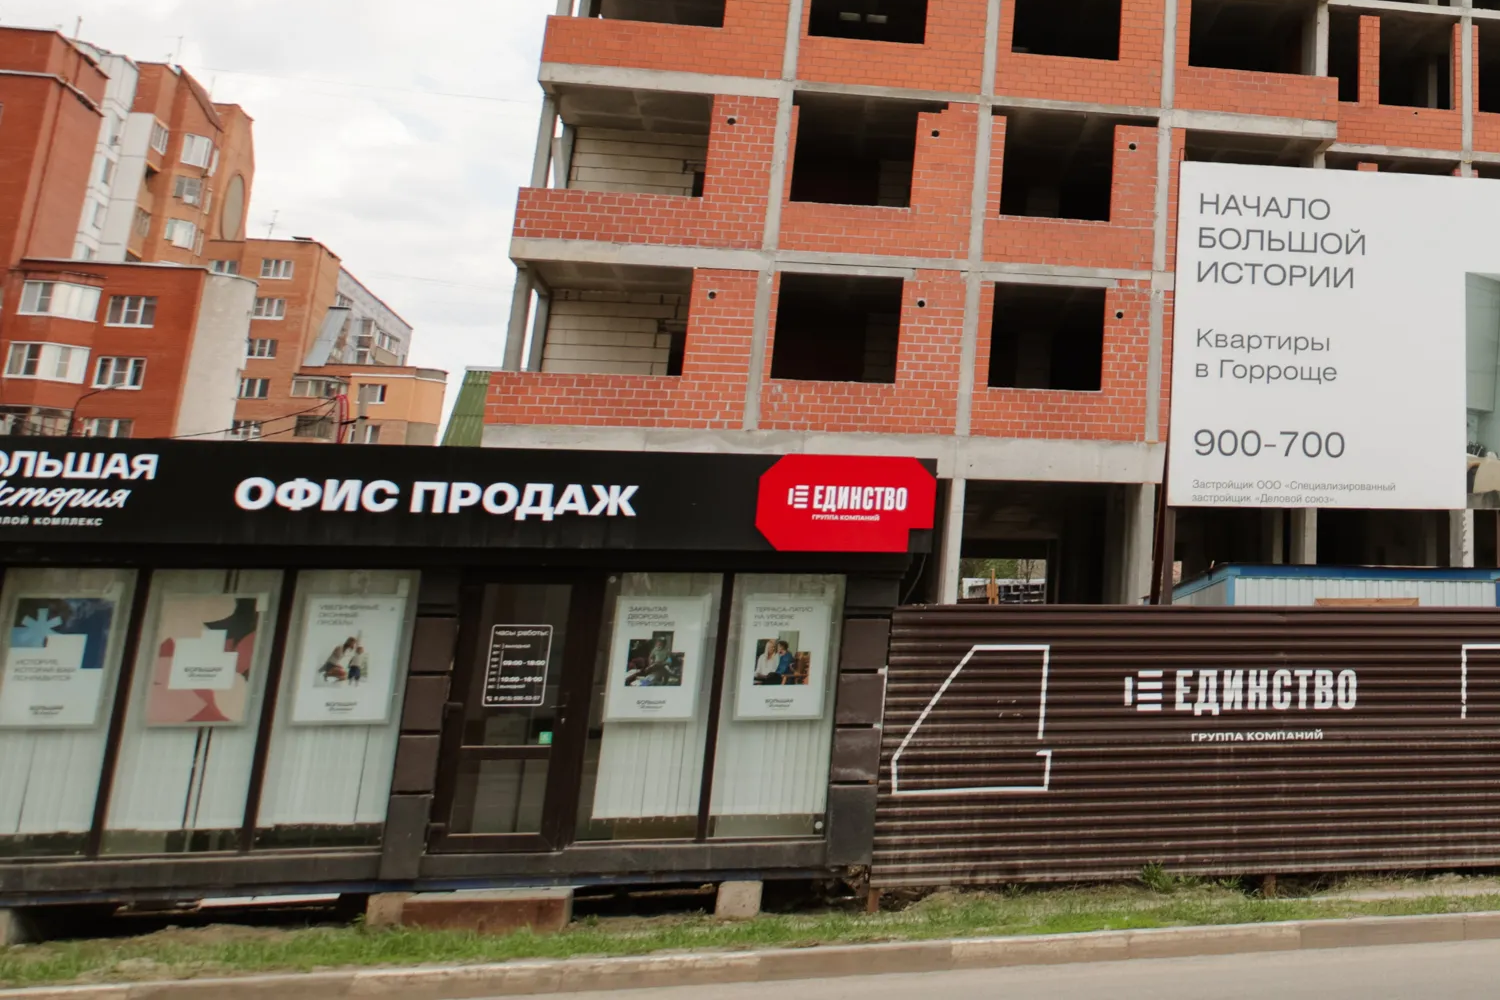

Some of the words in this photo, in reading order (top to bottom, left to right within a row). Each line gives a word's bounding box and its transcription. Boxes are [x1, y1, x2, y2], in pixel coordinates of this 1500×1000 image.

[1200, 193, 1330, 220] НАЧАЛО
[1199, 227, 1365, 255] БОЛЬШОЙ
[1197, 261, 1354, 288] ИСТОРИИ
[1196, 328, 1330, 355] Квартиры
[1195, 363, 1208, 378] в
[1219, 359, 1337, 384] Горроще
[1194, 429, 1345, 458] 900-700
[0, 480, 131, 516] стория
[234, 476, 400, 512] ОФИС
[410, 481, 639, 521] ПРОДАЖ
[812, 485, 908, 512] ЕДИНСТВО
[1191, 493, 1251, 504] застройщик
[1192, 480, 1253, 492] Застройщик
[1257, 480, 1282, 490] ООО
[33, 516, 103, 526] КОМПЛЕКС
[1175, 669, 1357, 716] ЕДИНСТВО
[1191, 732, 1244, 742] ГРУППА
[1247, 729, 1323, 741] КОМПАНИЙ
